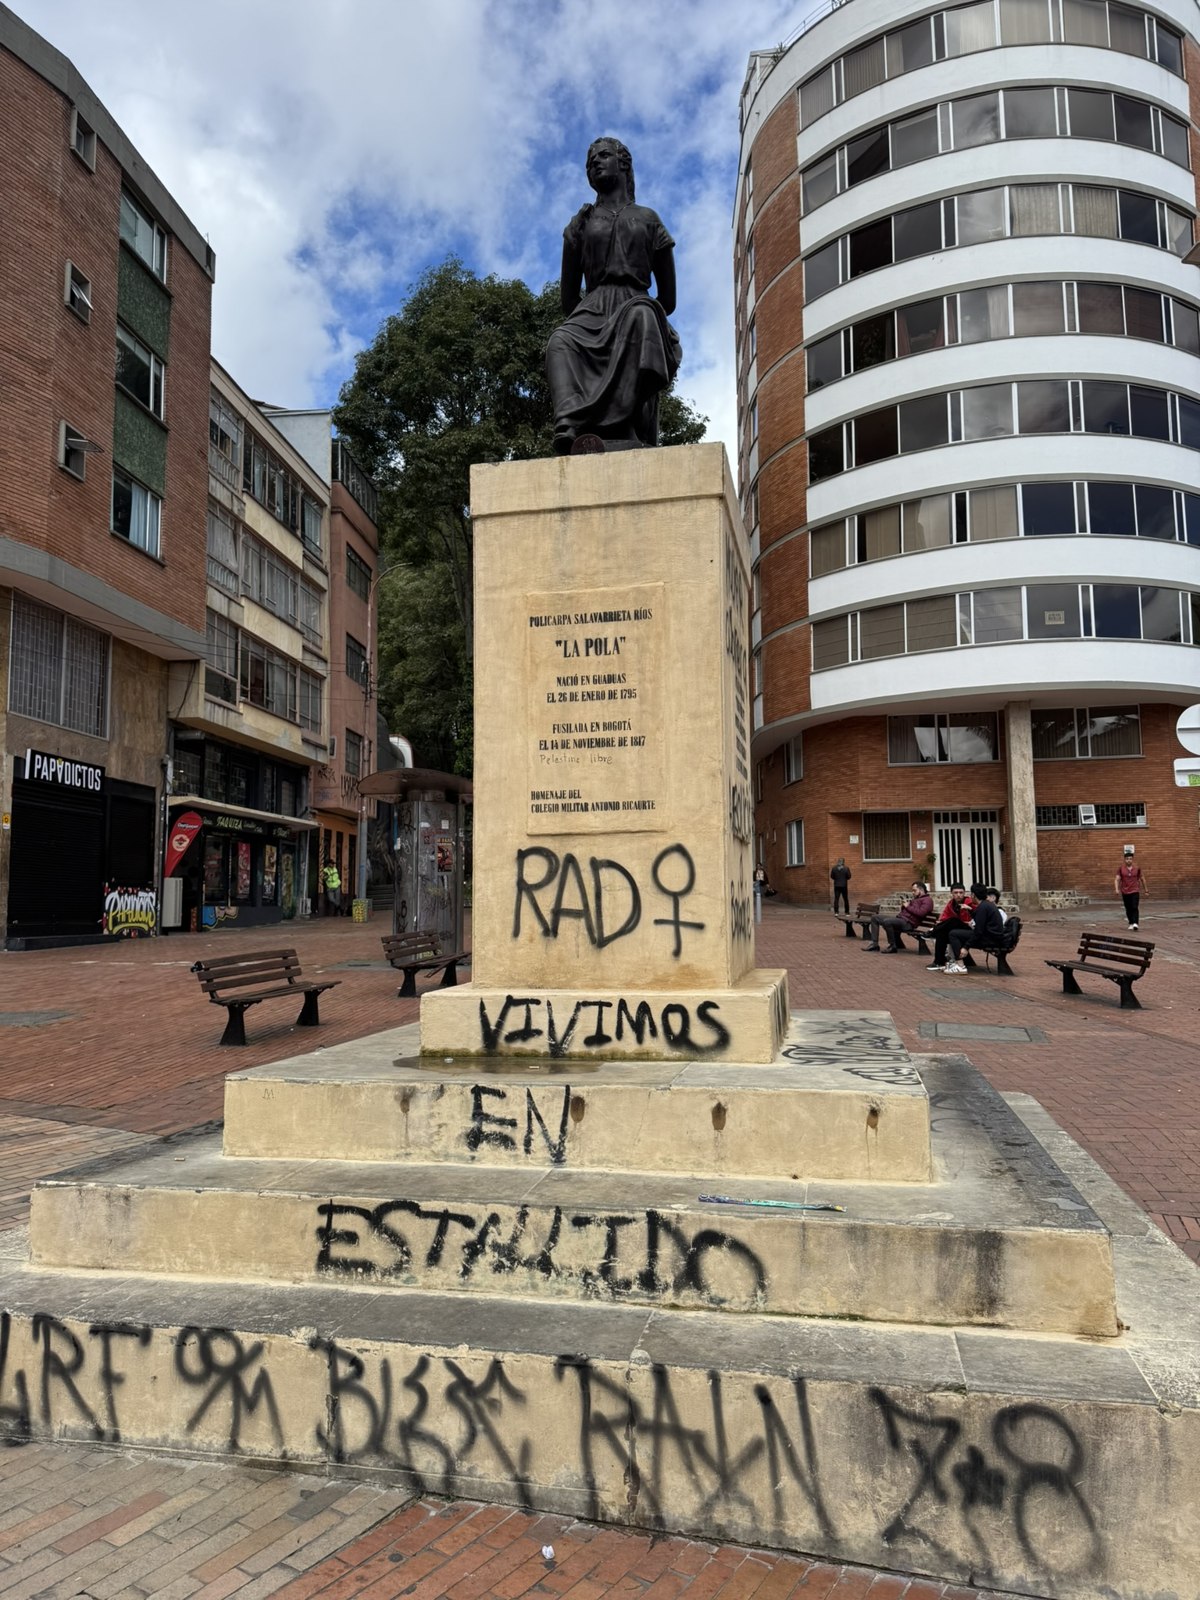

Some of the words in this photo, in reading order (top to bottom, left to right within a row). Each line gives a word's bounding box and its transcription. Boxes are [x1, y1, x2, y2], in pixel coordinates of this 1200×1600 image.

[530, 614, 572, 627] POLICARPA
[574, 609, 631, 624] SALAVARRIETA
[634, 607, 653, 621] RÍOS
[555, 640, 580, 658] "LA
[585, 636, 626, 657] POLA"
[557, 674, 579, 687] NACIÓ
[581, 675, 591, 686] EN
[593, 673, 627, 685] GUADUAS
[547, 692, 556, 703] EL
[558, 692, 567, 703] 26
[570, 691, 579, 702] DE
[582, 690, 606, 701] ENERO
[608, 689, 618, 700] DE
[620, 688, 637, 699] 1795
[552, 723, 588, 734] FUSILADA
[590, 722, 600, 732] EN
[602, 718, 632, 731] BOGOTÁ
[539, 740, 549, 750] EL
[561, 739, 570, 750] DE
[573, 737, 616, 749] NOVIEMBRE
[618, 736, 628, 747] DE
[631, 736, 646, 747] 1817
[34, 754, 102, 791] PAPADICTOS
[531, 790, 567, 800] HOMENAJE
[568, 789, 582, 799] DEL
[531, 803, 559, 813] COLEGIO
[561, 801, 589, 812] MILITAR
[591, 801, 620, 811] ANTONIO
[622, 799, 656, 810] RICAURTE
[479, 995, 731, 1055] VIVIMOS
[467, 1084, 571, 1163] EN
